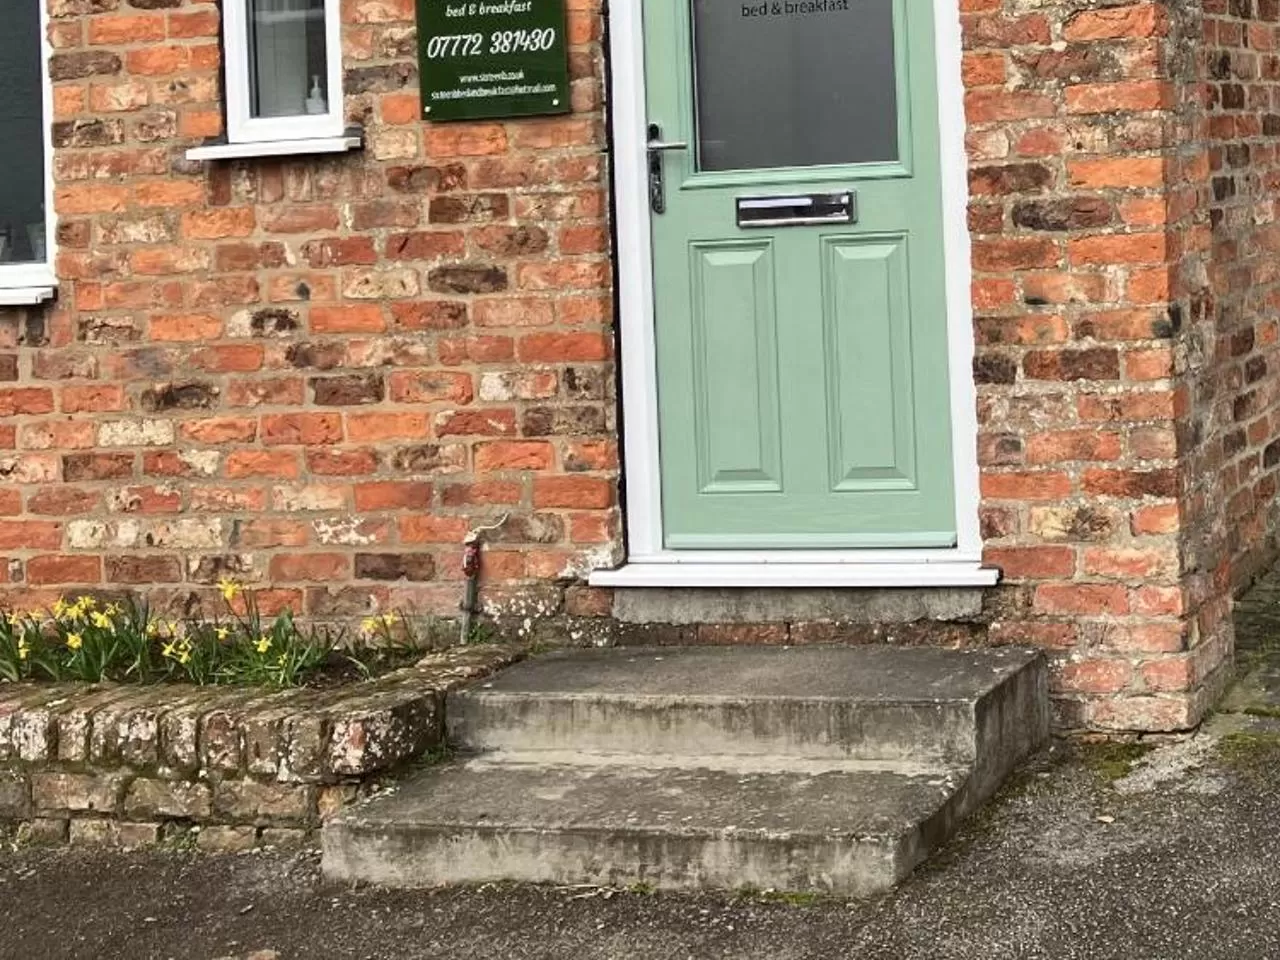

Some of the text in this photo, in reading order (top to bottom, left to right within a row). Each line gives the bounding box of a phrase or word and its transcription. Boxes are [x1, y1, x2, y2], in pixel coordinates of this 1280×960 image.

[445, 3, 466, 18] bed
[479, 0, 532, 16] breakfast
[741, 1, 767, 17] bed
[771, 2, 781, 15] &
[427, 27, 556, 59] 07772 381430
